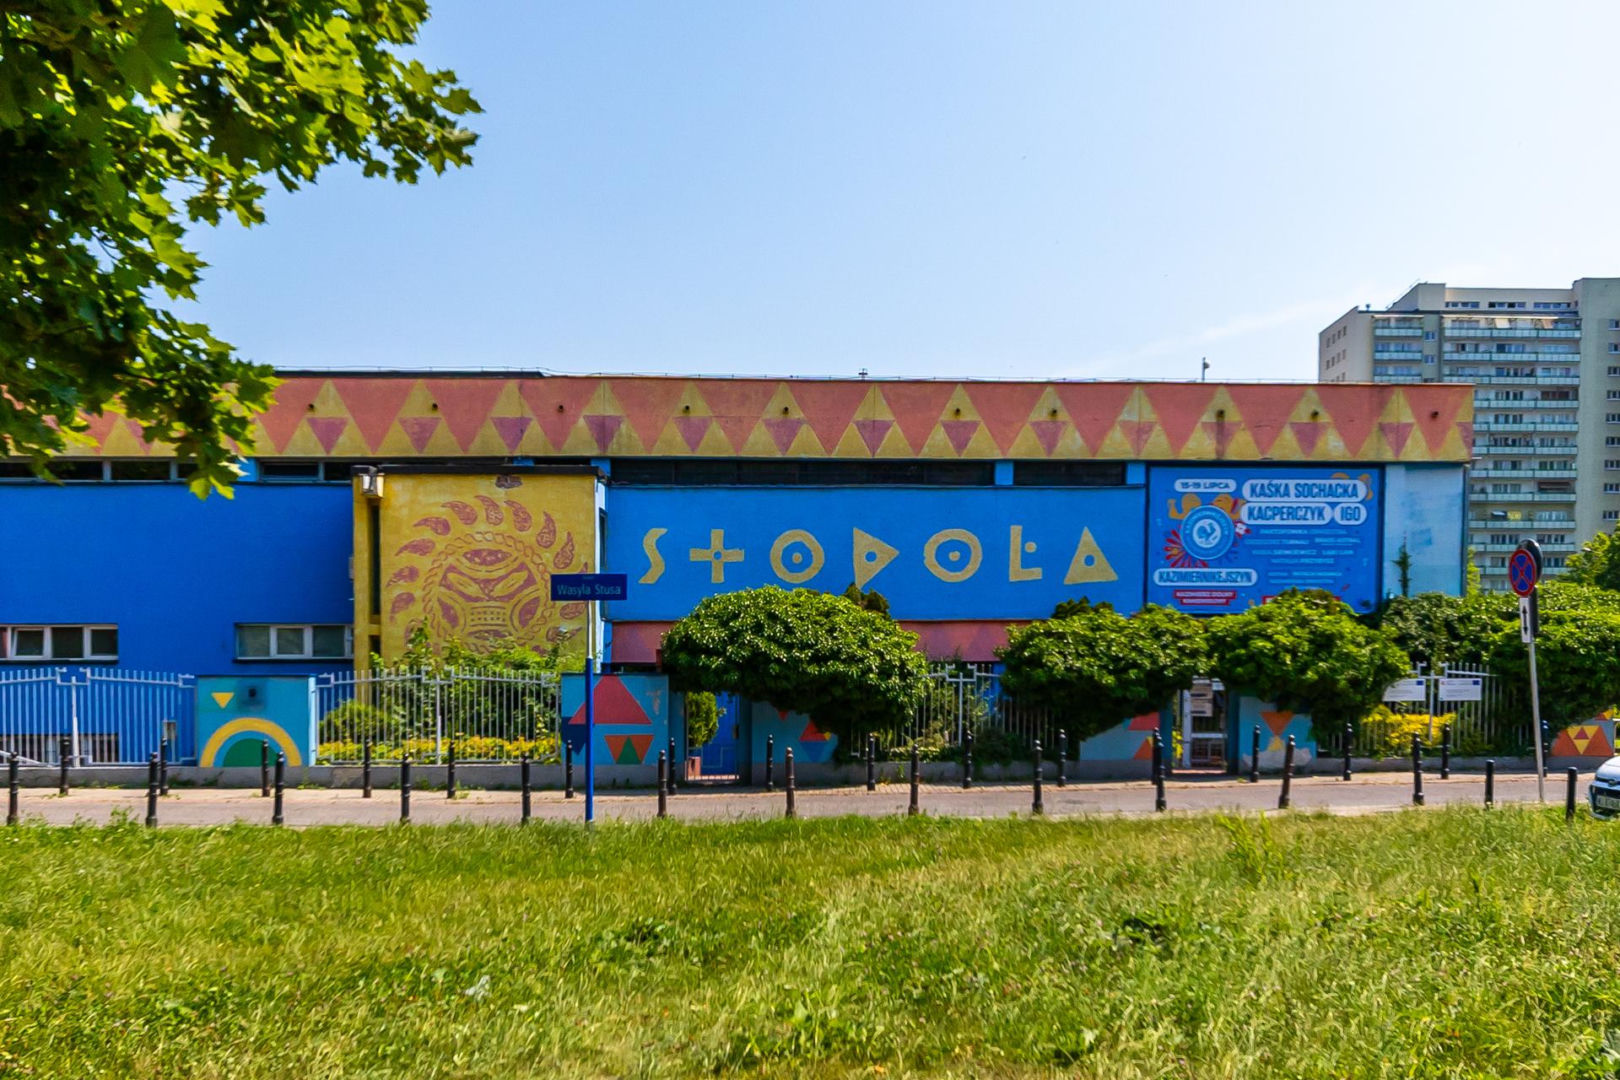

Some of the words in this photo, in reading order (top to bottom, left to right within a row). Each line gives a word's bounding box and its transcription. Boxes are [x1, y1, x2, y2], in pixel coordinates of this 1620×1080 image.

[1203, 481, 1230, 489] LIPCA
[1250, 480, 1291, 498] KAŚKA
[1294, 483, 1359, 498] SOCHACKA
[1247, 506, 1325, 521] KACPERCZYK
[1340, 506, 1361, 521] IGO
[556, 583, 591, 598] Wasyla
[594, 583, 622, 595] Stusa
